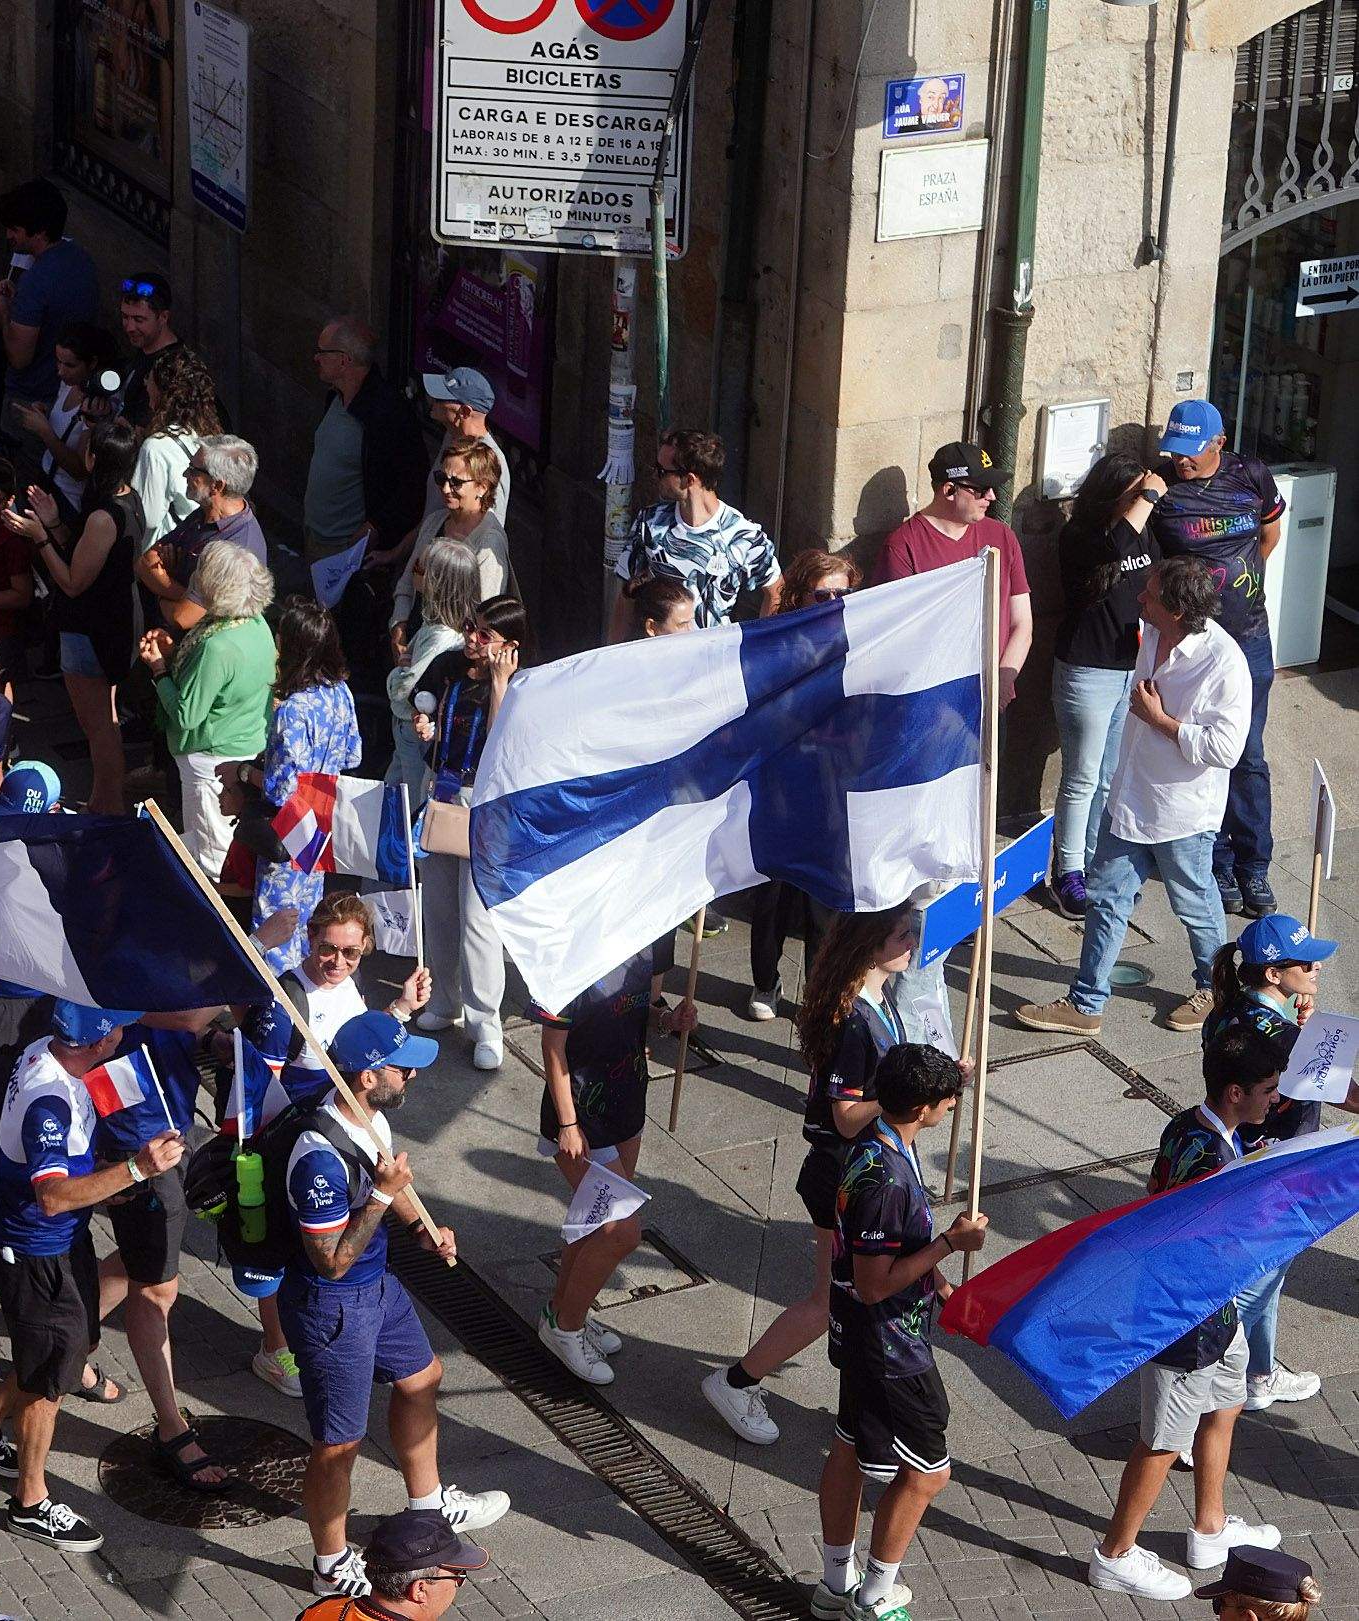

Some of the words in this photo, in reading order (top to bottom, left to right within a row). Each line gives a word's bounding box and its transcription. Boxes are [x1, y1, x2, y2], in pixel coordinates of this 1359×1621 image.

[530, 38, 599, 61] AGÁS
[506, 68, 622, 90] BICICLETAS
[458, 106, 529, 124] CARGA
[536, 111, 547, 126] E
[555, 112, 667, 132] DESCARGA
[893, 115, 919, 128] JAUME
[921, 112, 951, 125] VAQUER
[452, 129, 517, 142] LABORAIS
[522, 132, 539, 143] DE
[543, 134, 551, 144] 8
[556, 135, 565, 145] A
[569, 136, 581, 146] 12
[586, 137, 593, 146] E
[598, 137, 615, 148] DE
[620, 138, 632, 149] 16
[636, 139, 646, 150] A
[453, 145, 488, 158] MAX:
[493, 148, 509, 158] 30
[513, 149, 543, 161] MIN.
[548, 151, 555, 161] E
[923, 171, 957, 187] PRAZA
[488, 185, 634, 208] AUTORIZADOS
[919, 188, 959, 207] ESPAÑA
[549, 210, 562, 219] 10
[567, 211, 632, 224] MINUTOS
[1308, 262, 1343, 276] ENTRADA
[1302, 278, 1311, 288] LA
[1313, 275, 1333, 285] OTRA
[26, 788, 42, 799] DU
[22, 804, 42, 814] LON
[24, 797, 45, 808] ATH
